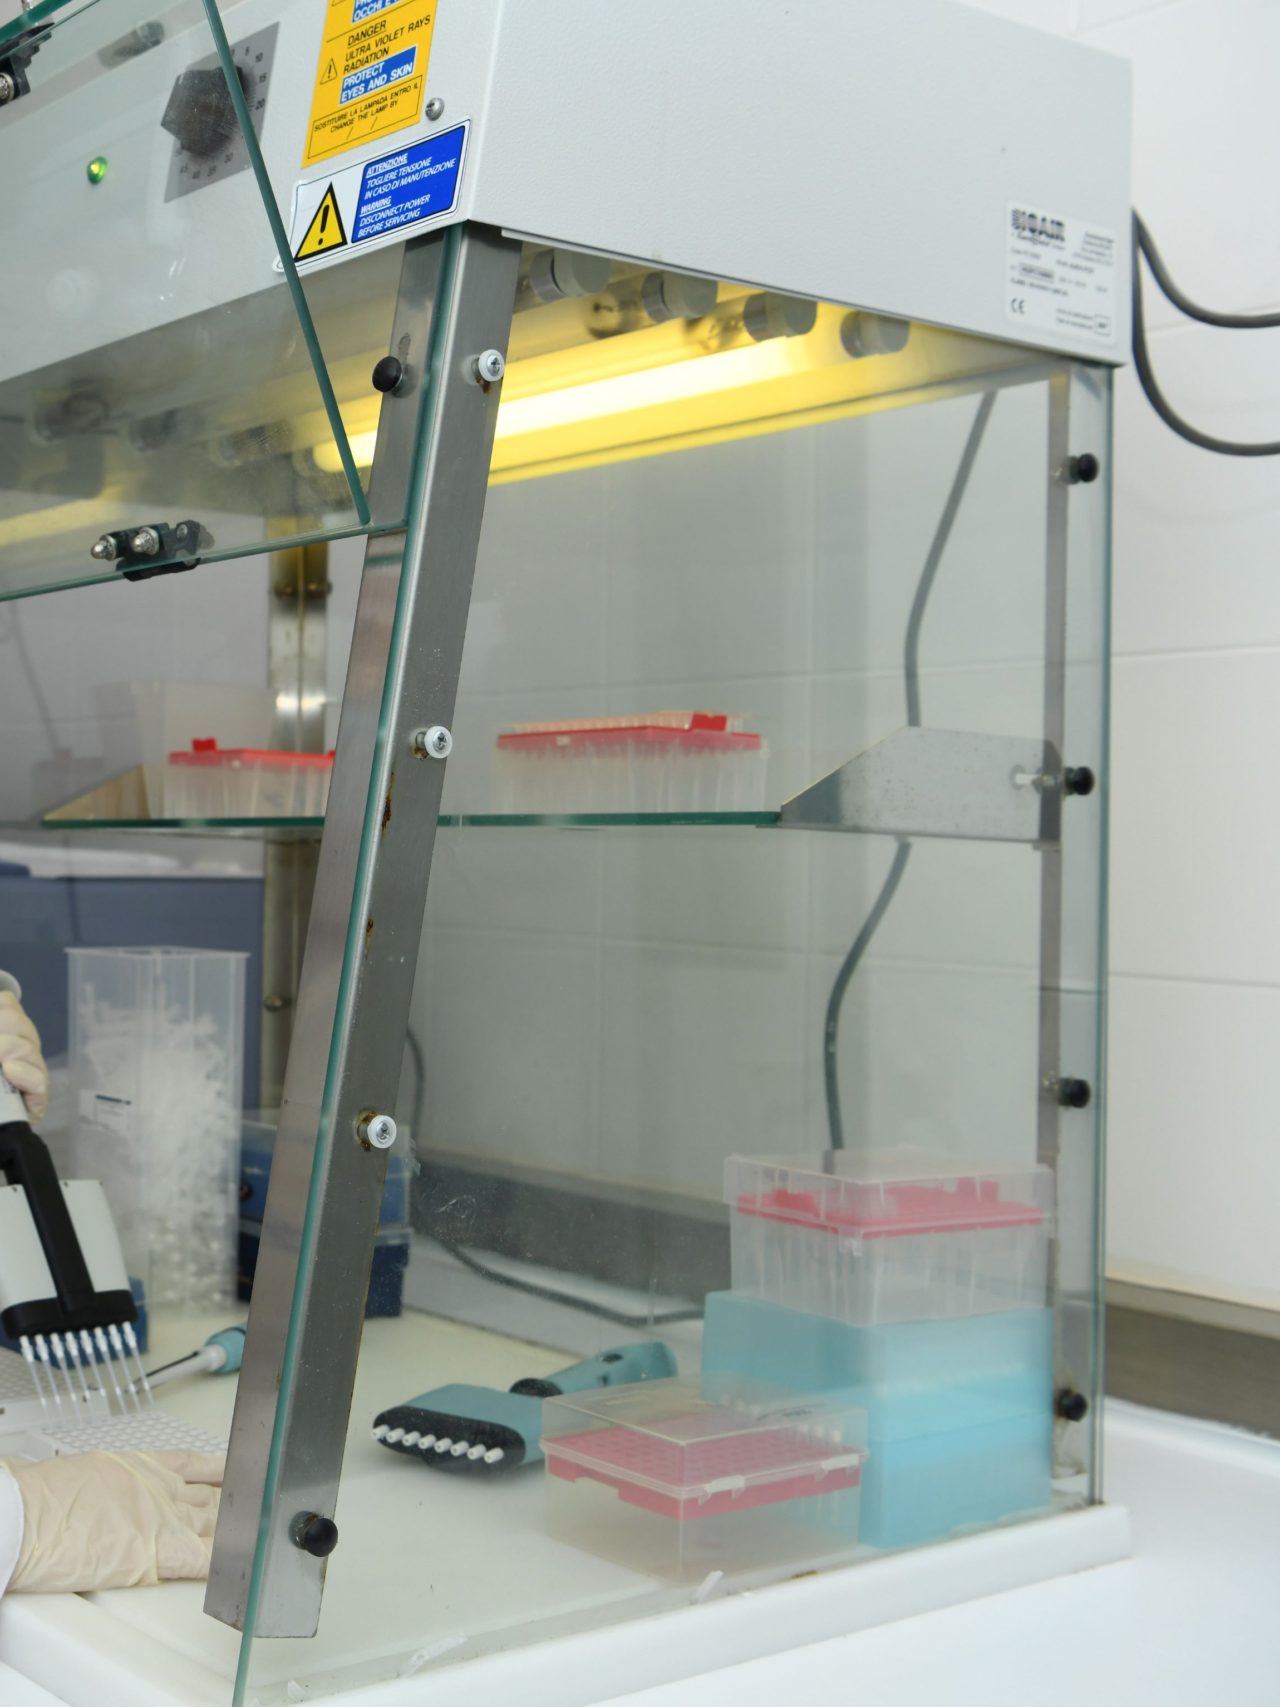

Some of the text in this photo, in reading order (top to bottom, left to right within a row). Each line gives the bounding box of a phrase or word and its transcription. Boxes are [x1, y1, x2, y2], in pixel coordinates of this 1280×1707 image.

[345, 14, 431, 62] ULTRA VIOLET RAYS
[348, 20, 387, 46] DANGER
[343, 46, 390, 74] RADIATION
[341, 62, 413, 102] EYES AND SKIN
[343, 62, 385, 89] PROTECT
[349, 107, 358, 118] LA
[359, 95, 388, 113] LAMPADA
[390, 85, 412, 100] ENTRO
[330, 120, 354, 133] CHANGE
[357, 113, 369, 121] THE
[370, 105, 389, 117] LAMP
[364, 188, 372, 200] IN
[372, 182, 392, 197] CASO
[400, 158, 457, 187] MANUTENZIONE
[365, 153, 408, 177] ATTENZIONE
[366, 156, 433, 189] TOGLIERE TENSIONE
[360, 196, 392, 215] WARNING
[360, 194, 431, 227] DISCONNECT POWER
[358, 208, 421, 238] BEFORE SERVICING
